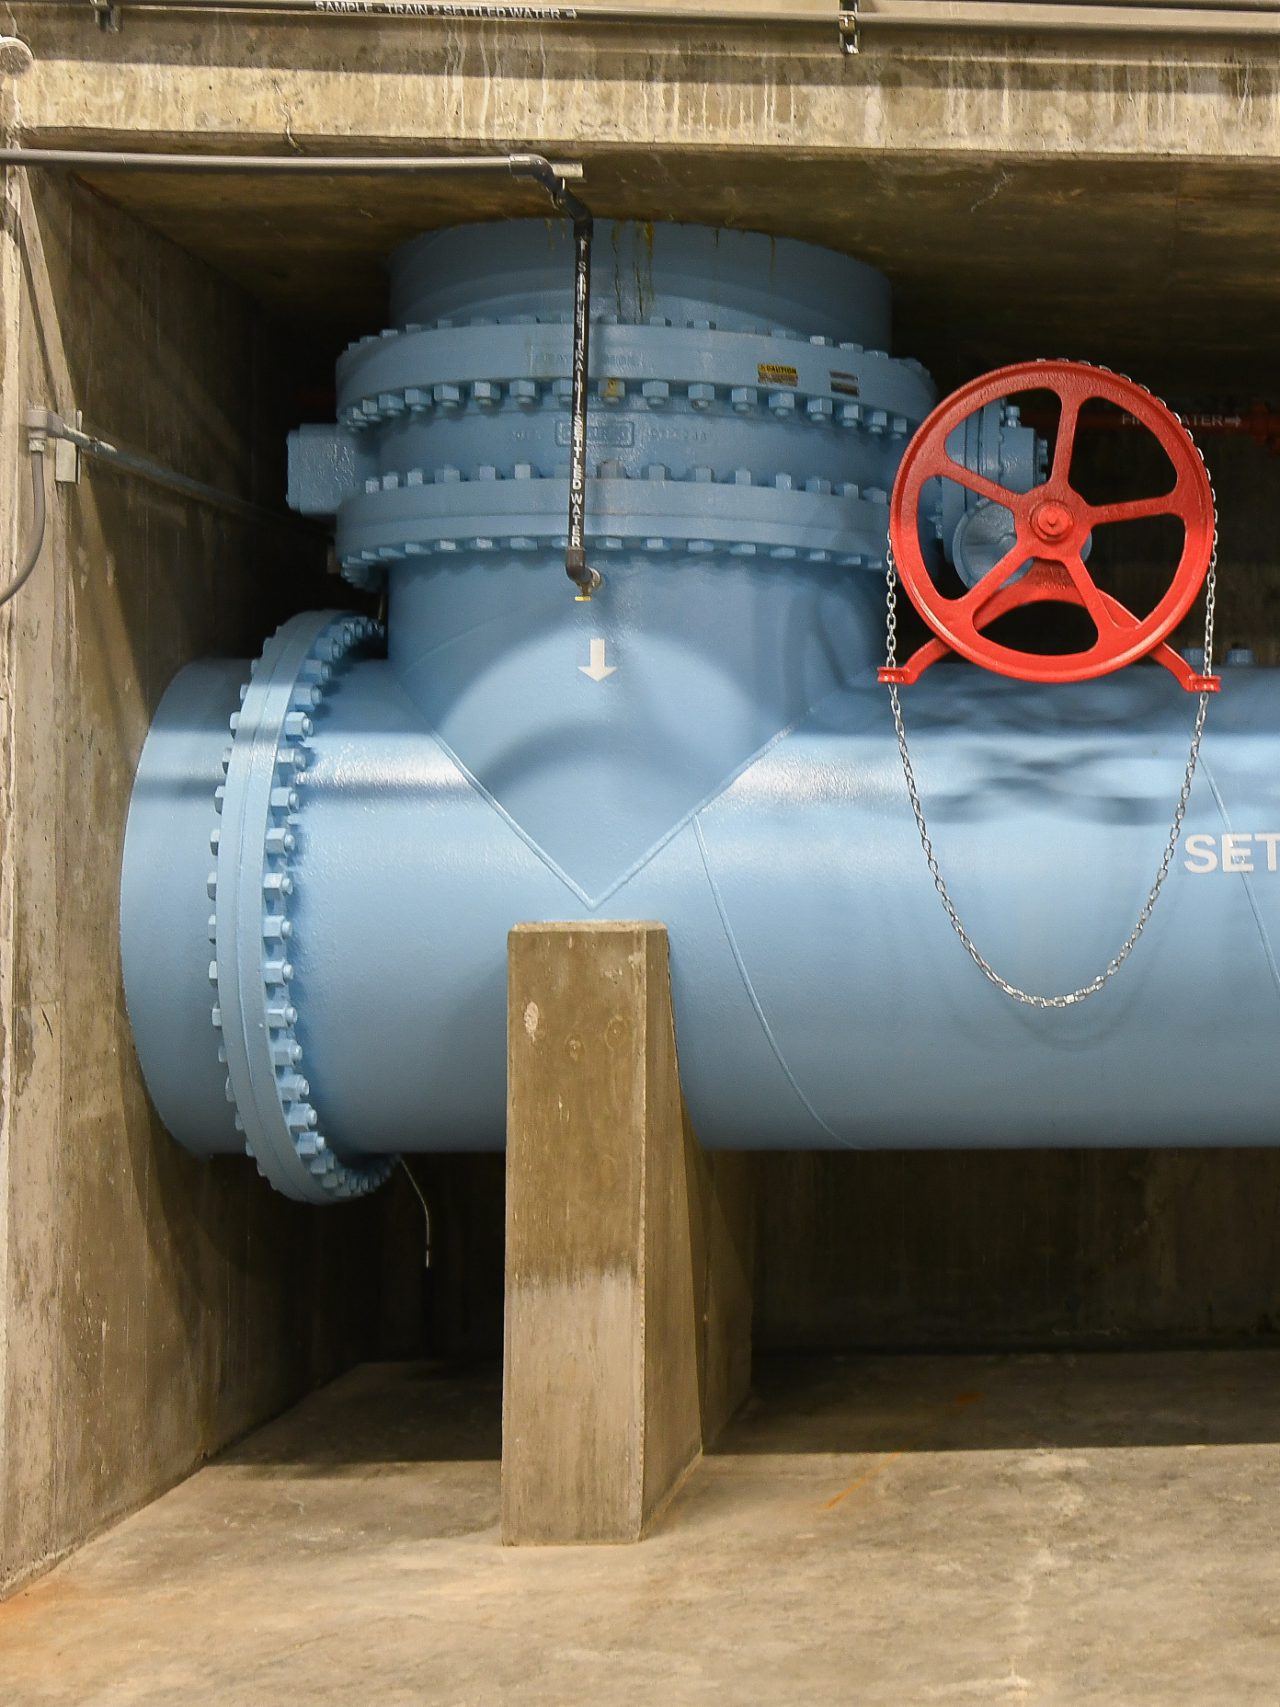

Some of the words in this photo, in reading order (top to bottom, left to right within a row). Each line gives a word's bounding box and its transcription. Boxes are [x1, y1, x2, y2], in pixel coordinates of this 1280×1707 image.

[315, 0, 372, 13] SAMPLE
[385, 3, 429, 15] TRAIN
[443, 5, 506, 17] SETTLED
[509, 7, 561, 19] WATER
[573, 414, 584, 490] SETTLED
[571, 492, 583, 548] WATER
